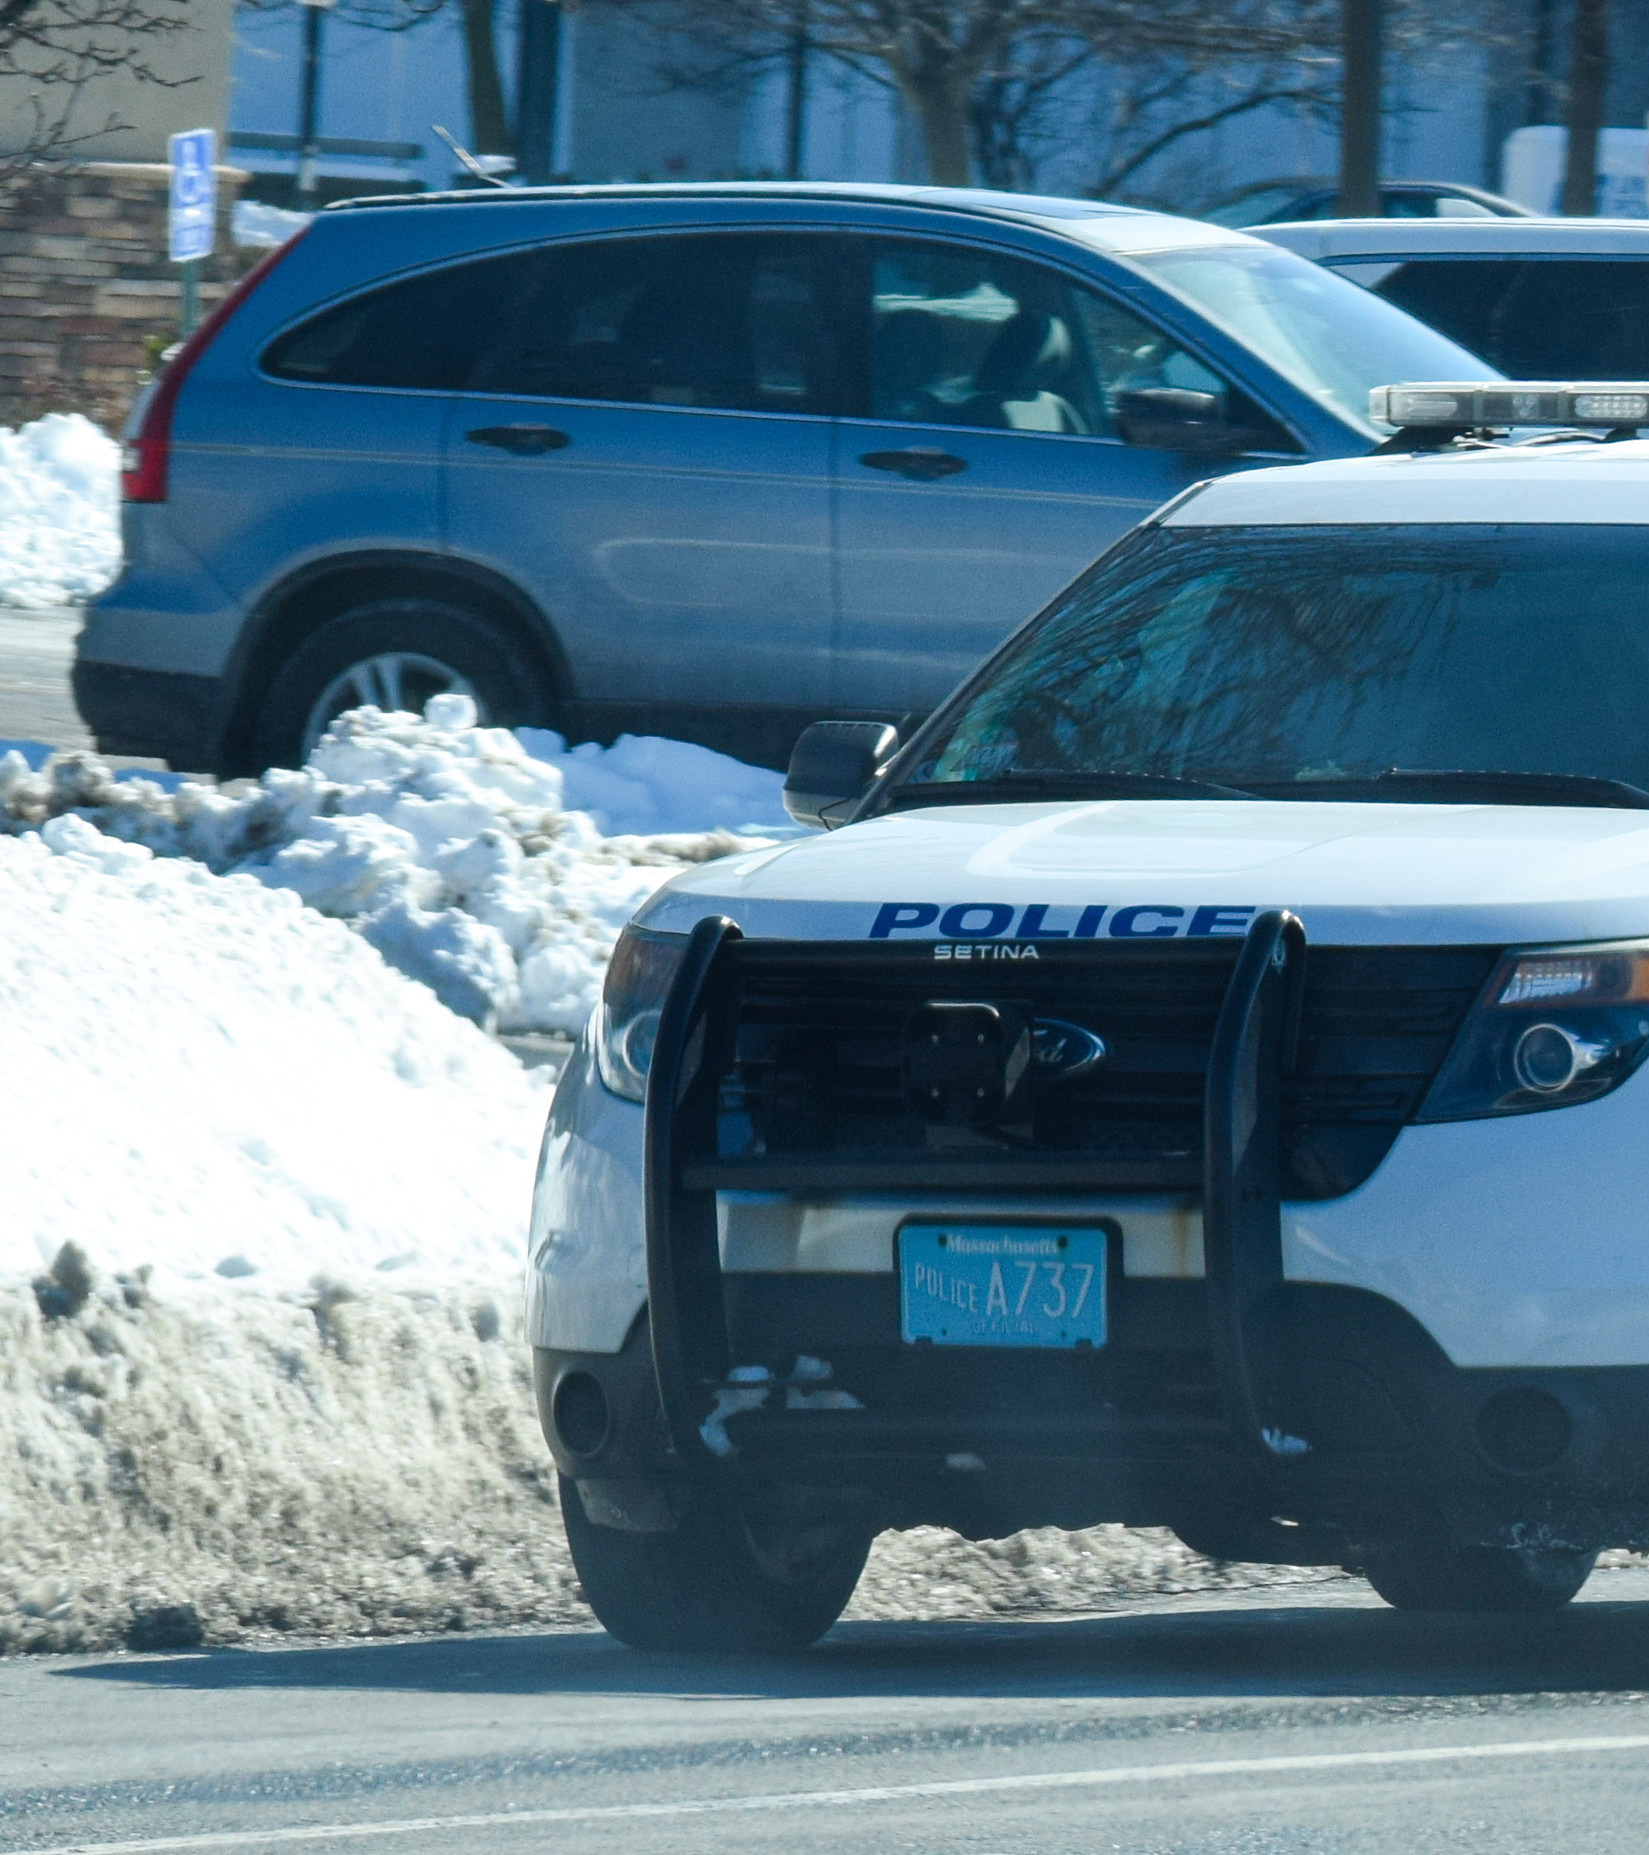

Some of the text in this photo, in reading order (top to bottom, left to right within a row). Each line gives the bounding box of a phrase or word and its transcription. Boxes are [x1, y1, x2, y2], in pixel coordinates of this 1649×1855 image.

[869, 902, 1257, 939] POLICE
[933, 944, 1040, 960] SETINA
[947, 1235, 1059, 1255] Massachusetts
[915, 1260, 1095, 1318] POLICE A737
